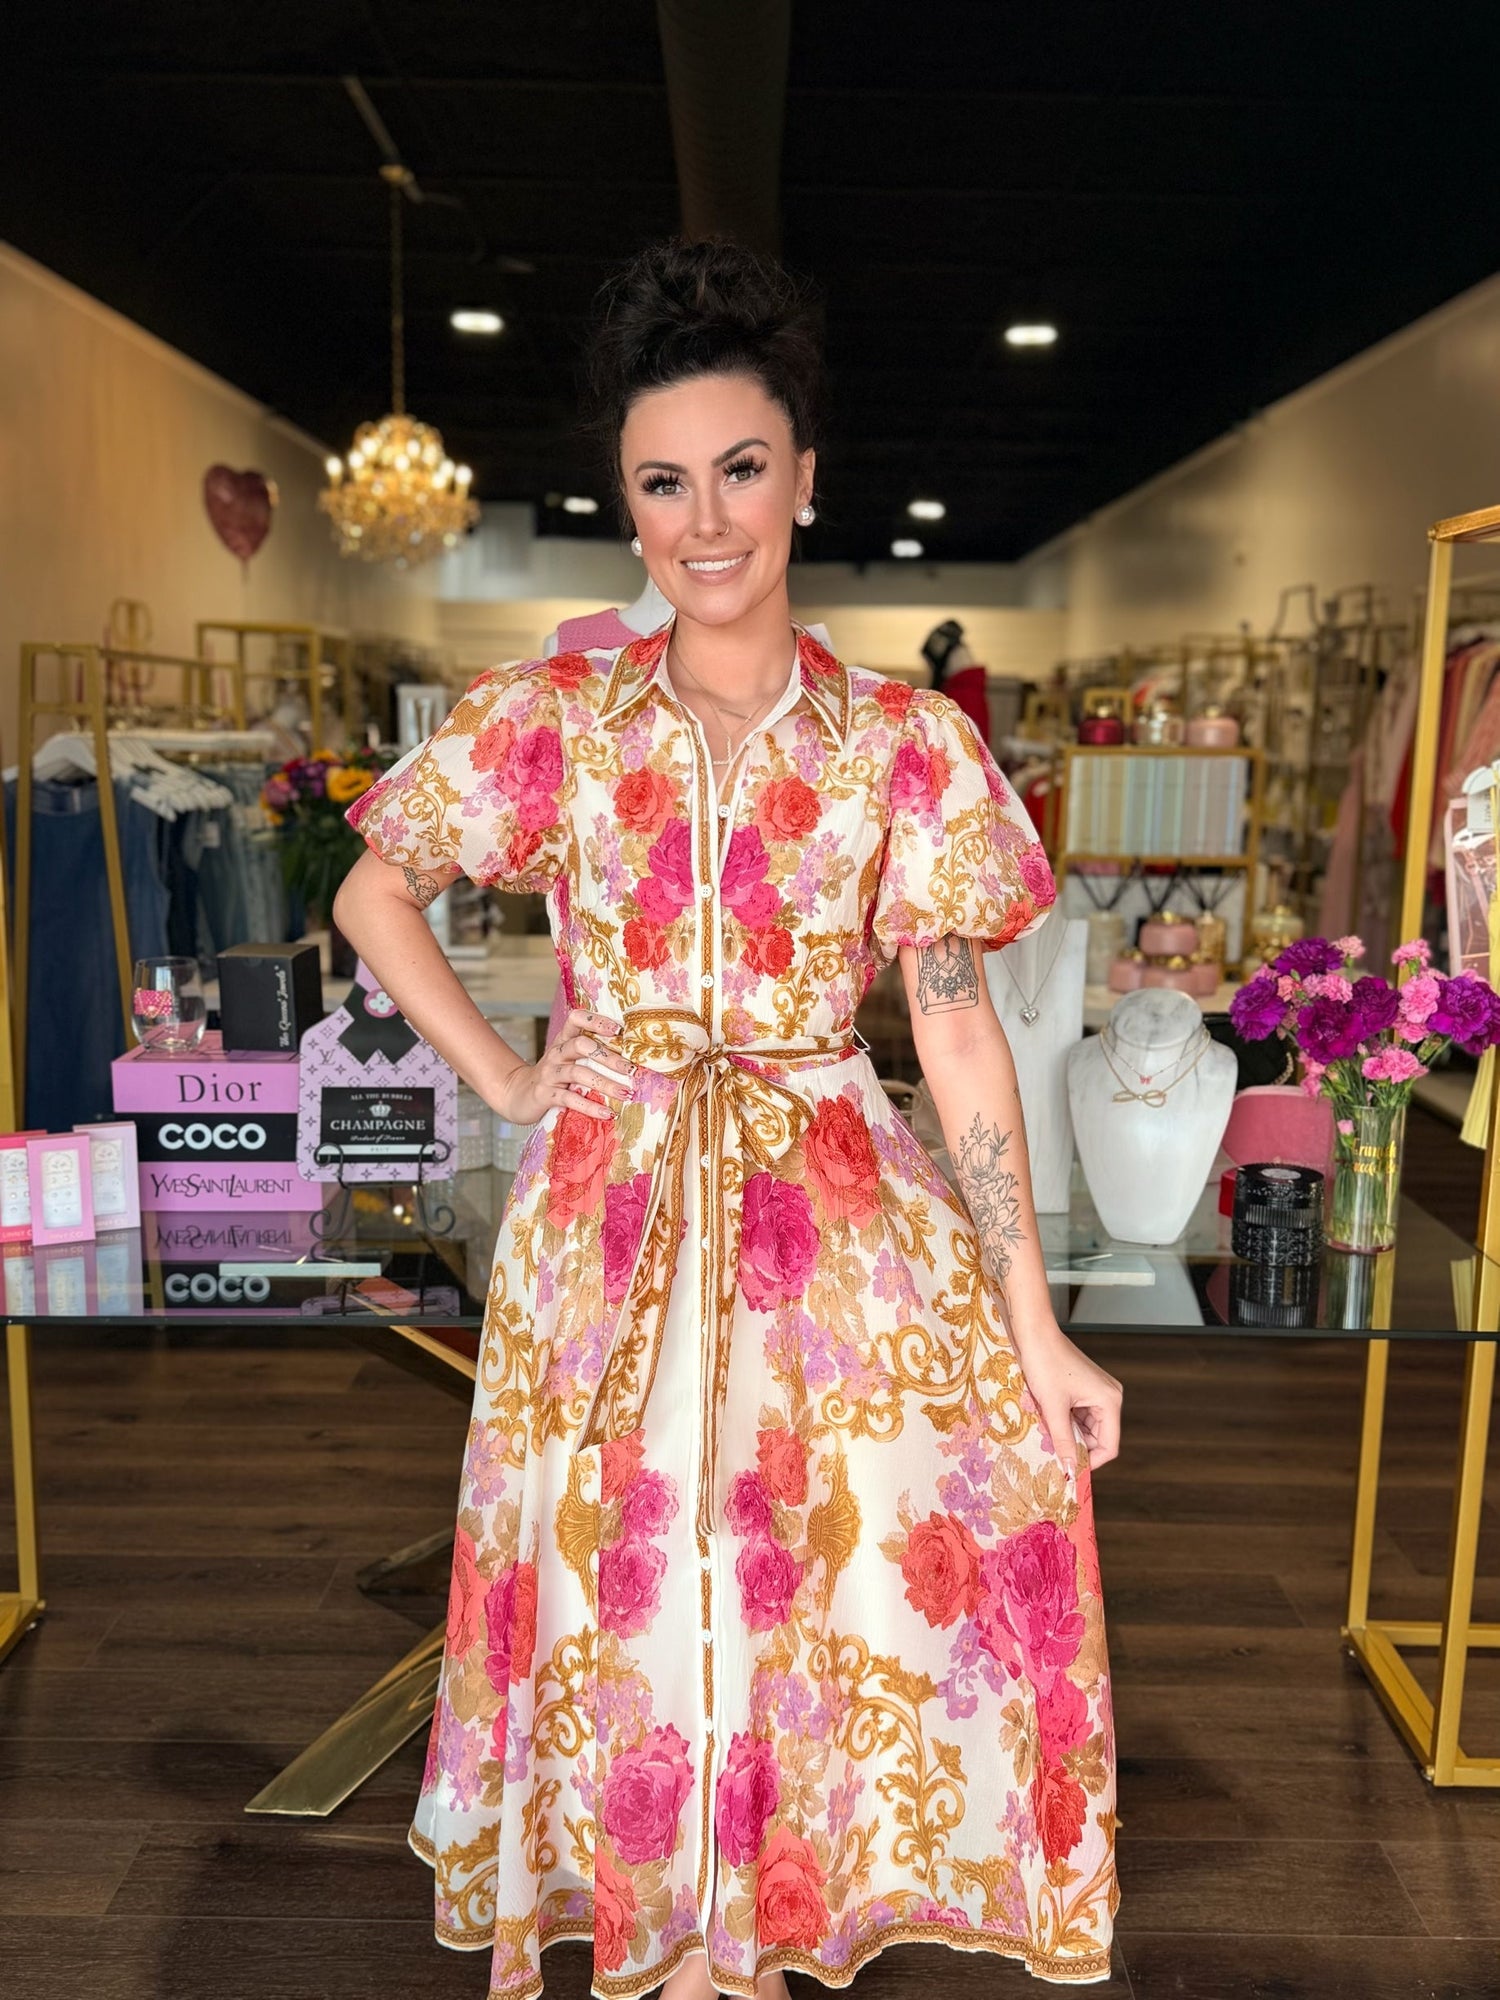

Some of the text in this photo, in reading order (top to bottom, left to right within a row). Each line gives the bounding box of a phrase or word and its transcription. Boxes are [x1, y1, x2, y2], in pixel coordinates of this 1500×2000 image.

[176, 1073, 263, 1103] Dior
[158, 1123, 267, 1150] COCO
[330, 1119, 426, 1131] CHAMPAGNE
